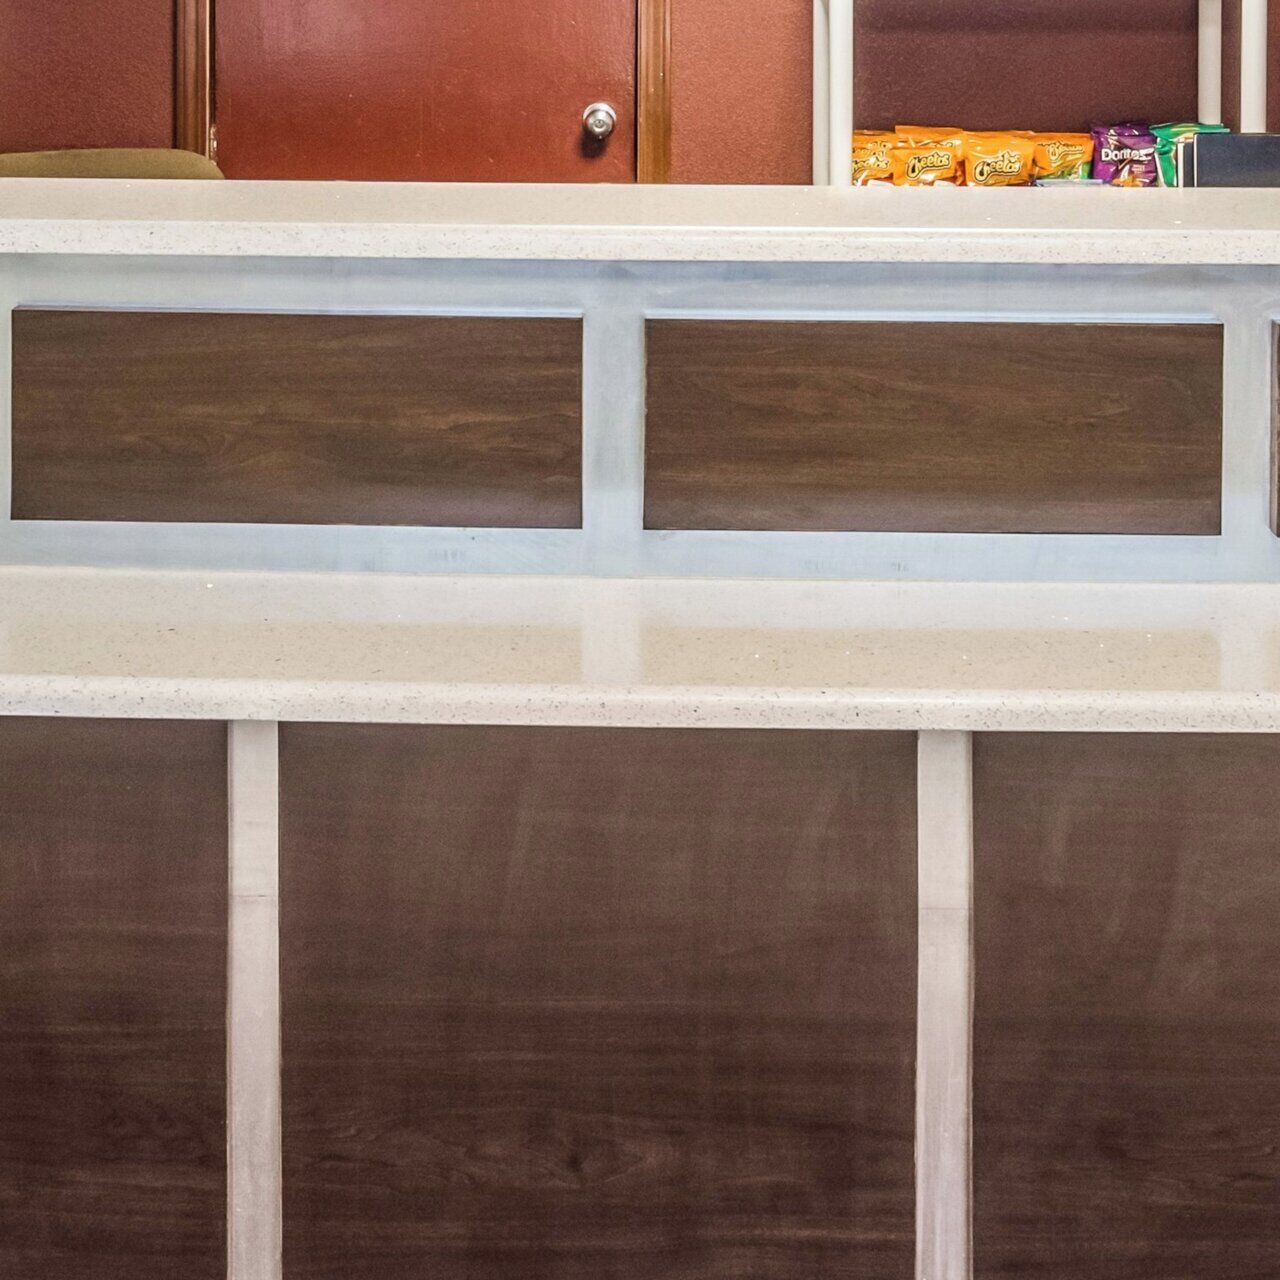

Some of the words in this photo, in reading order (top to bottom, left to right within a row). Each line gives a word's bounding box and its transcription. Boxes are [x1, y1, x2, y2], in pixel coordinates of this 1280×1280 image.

[907, 152, 951, 179] Cheetos
[975, 151, 1021, 182] Cheetos
[1101, 147, 1153, 161] Doritos
